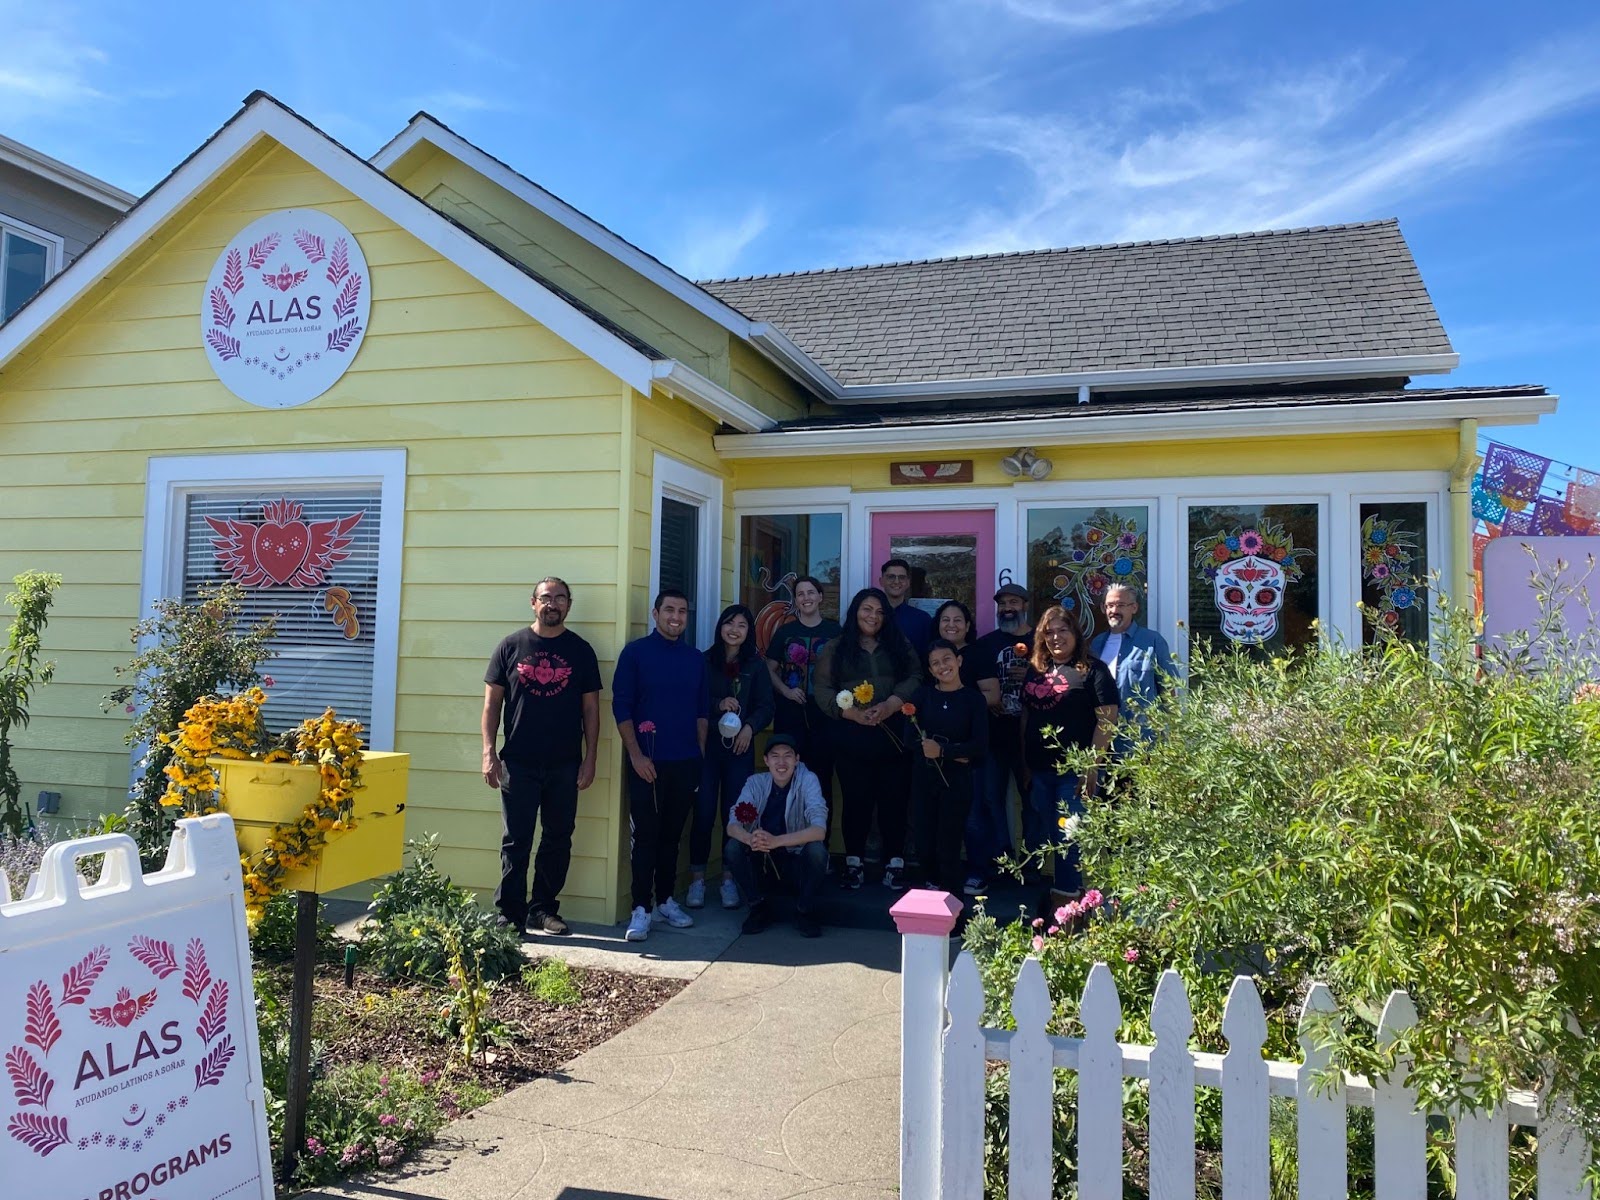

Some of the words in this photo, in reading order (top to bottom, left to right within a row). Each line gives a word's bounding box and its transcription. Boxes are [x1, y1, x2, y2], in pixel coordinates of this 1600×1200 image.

[246, 295, 321, 325] ALAS
[246, 329, 274, 337] AYUDANDO
[275, 327, 298, 335] LATINOS
[303, 325, 322, 333] SOÑAR
[545, 685, 562, 697] ALAS
[73, 1020, 183, 1091] ALAS
[74, 1086, 120, 1108] AYUDANDO
[120, 1072, 153, 1092] LATINOS
[153, 1069, 161, 1078] A
[160, 1058, 186, 1077] SOÑAR
[98, 1133, 232, 1200] PROGRAMS
